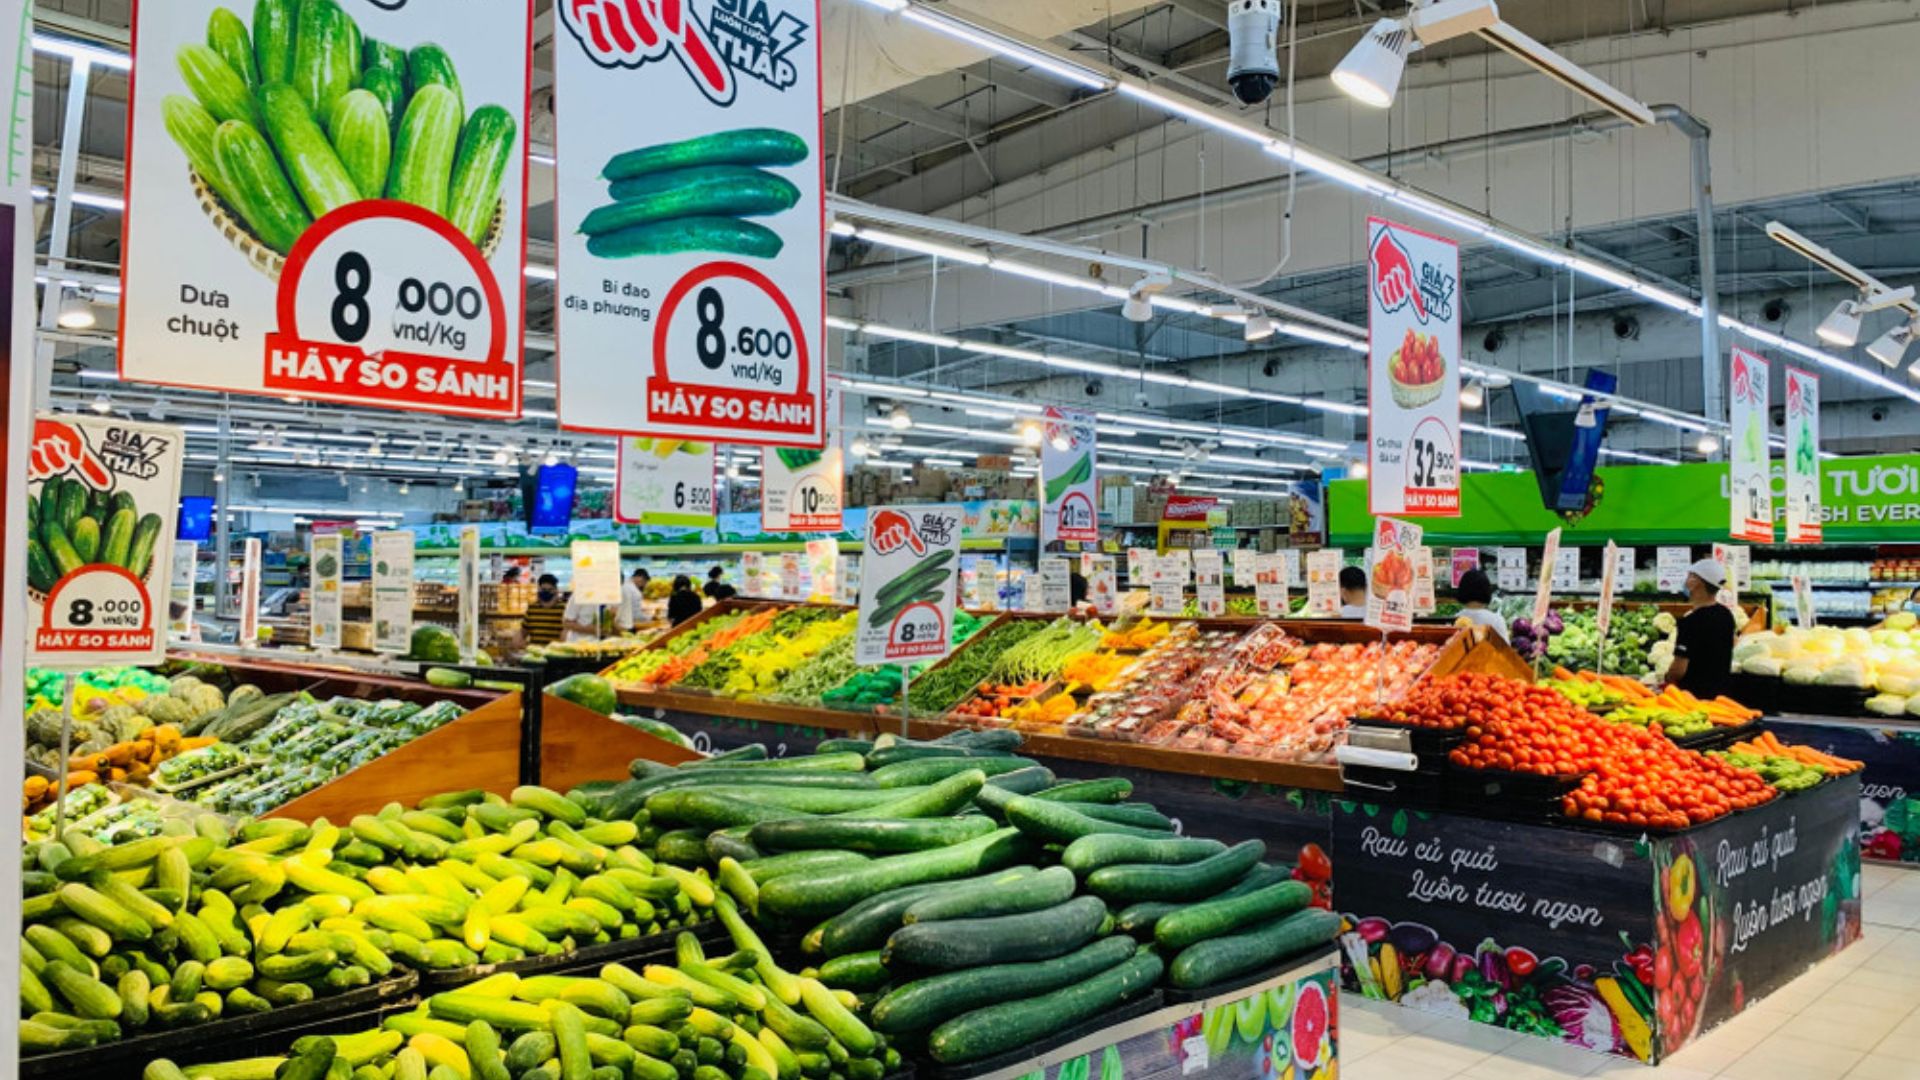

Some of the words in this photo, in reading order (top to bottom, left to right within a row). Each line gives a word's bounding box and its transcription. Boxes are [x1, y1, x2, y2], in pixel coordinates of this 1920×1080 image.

[180, 283, 230, 309] Dưa
[331, 250, 371, 343] 8
[621, 282, 651, 299] đao
[564, 295, 589, 312] địa
[592, 300, 651, 322] phương
[166, 314, 240, 343] chuột
[696, 286, 727, 370] 8
[271, 347, 352, 383] HÃY
[358, 359, 408, 390] SO
[415, 364, 509, 400] SÁNH
[651, 387, 706, 417] HÃY
[710, 397, 744, 421] SO
[749, 397, 812, 426] SÁNH
[1414, 438, 1436, 487] 32
[1827, 464, 1919, 497] TƯƠI
[673, 481, 685, 510] 6
[801, 485, 819, 514] 10
[68, 599, 94, 626] 8
[78, 634, 104, 647] SO
[107, 632, 151, 648] SÁNH
[900, 622, 915, 642] 8
[1858, 782, 1908, 800] gon
[1360, 826, 1409, 858] Rau
[1414, 837, 1443, 863] củ
[1449, 846, 1499, 874] quả
[1716, 838, 1749, 889] Rau
[1407, 868, 1469, 903] Luôn
[1531, 899, 1605, 929] ngon
